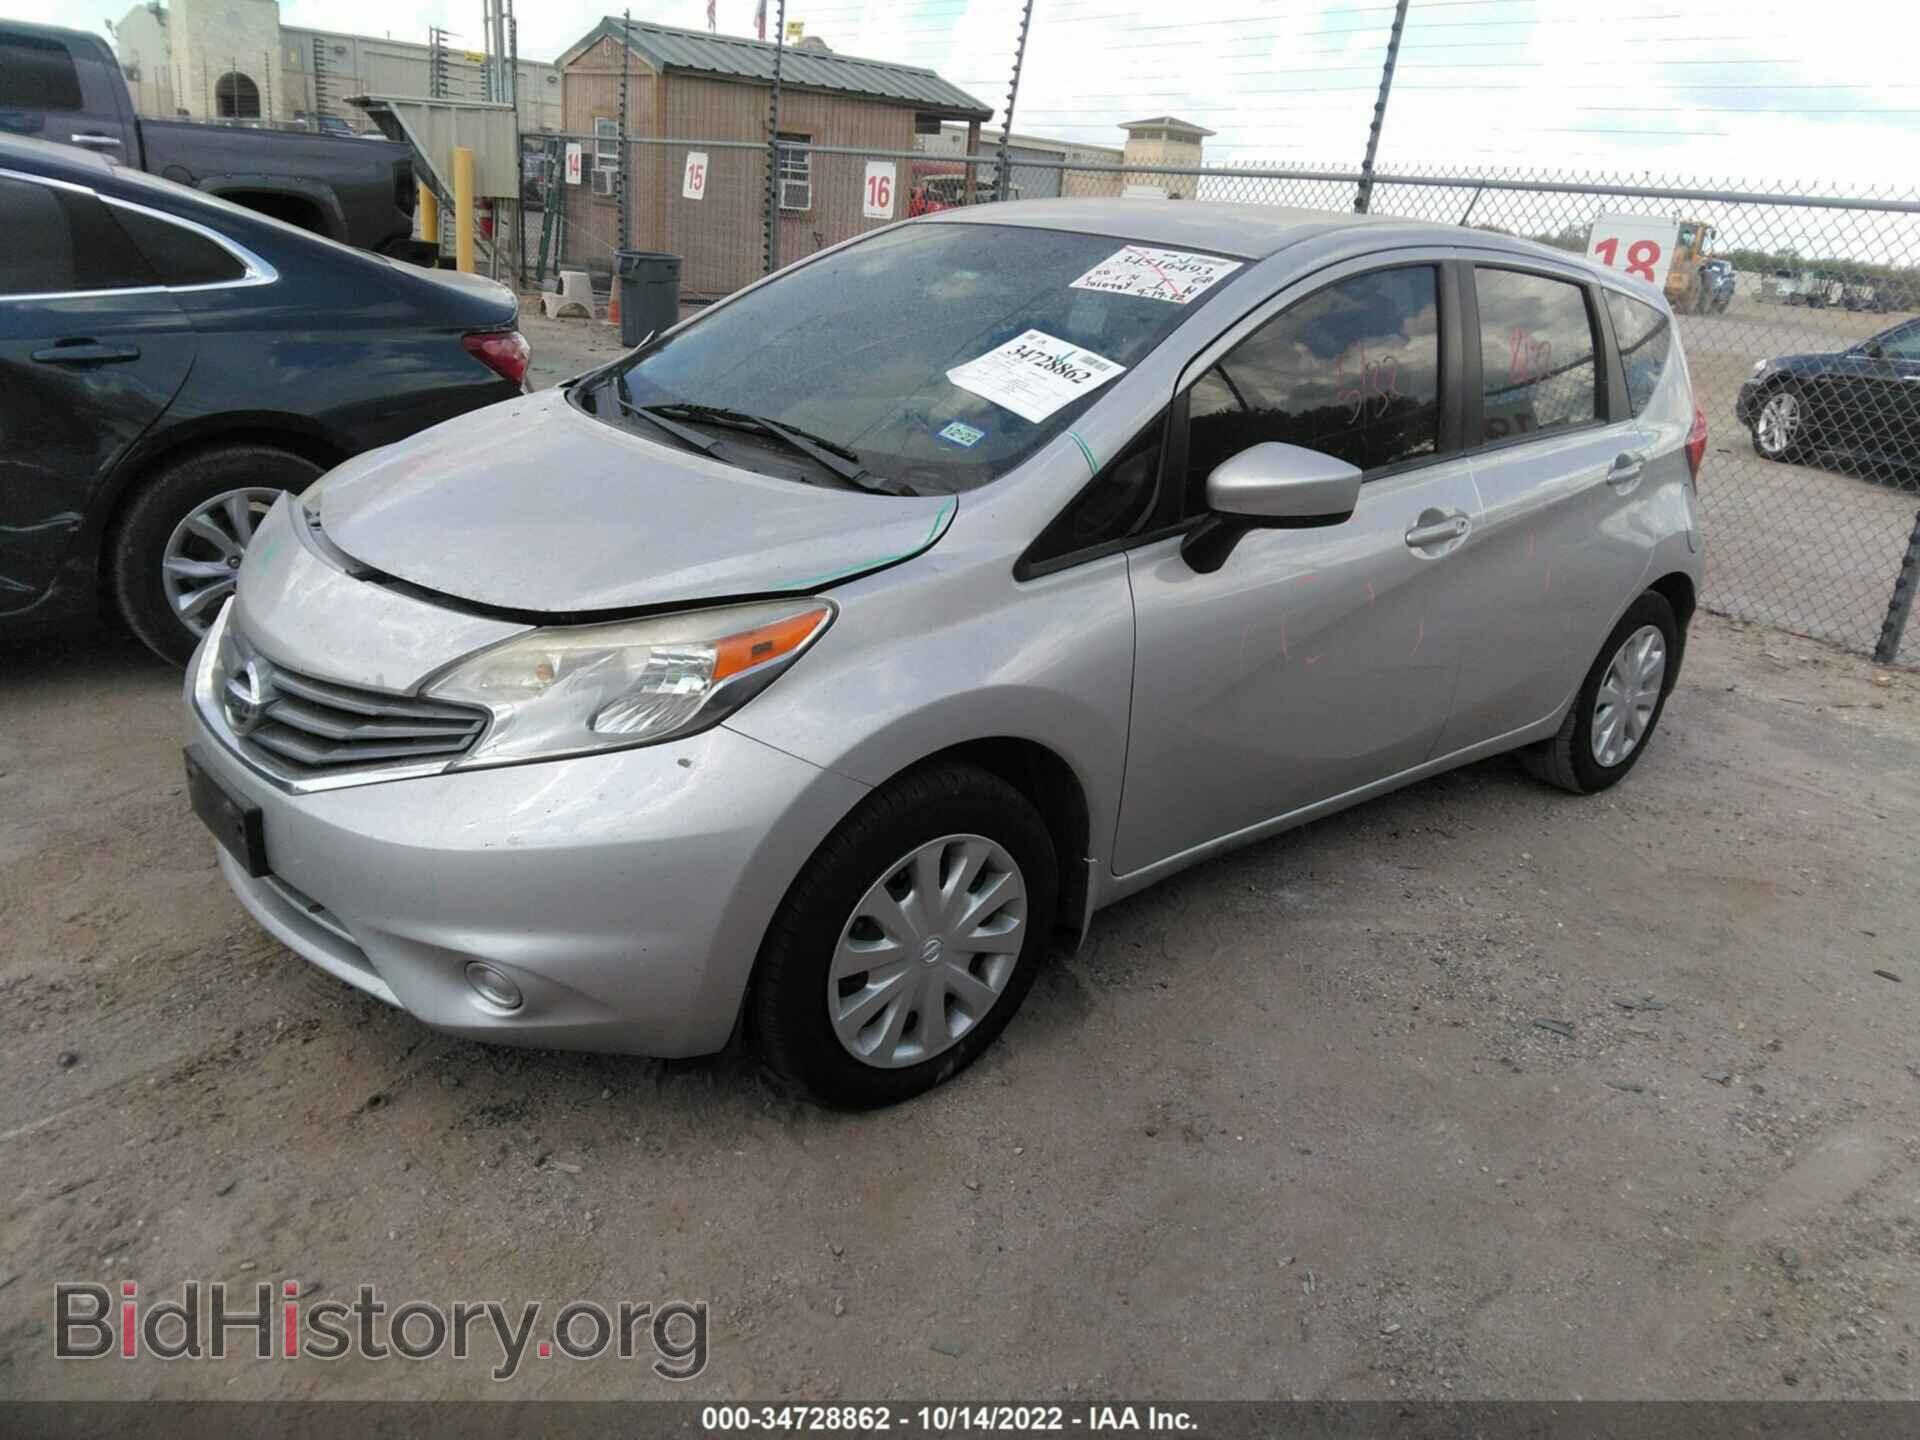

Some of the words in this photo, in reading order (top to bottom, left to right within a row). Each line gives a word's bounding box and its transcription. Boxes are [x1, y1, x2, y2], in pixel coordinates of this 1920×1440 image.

[568, 153, 580, 176] 14
[687, 164, 704, 190] 15
[868, 175, 890, 207] 16
[1594, 238, 1661, 283] 18
[1007, 344, 1092, 384] 34728862
